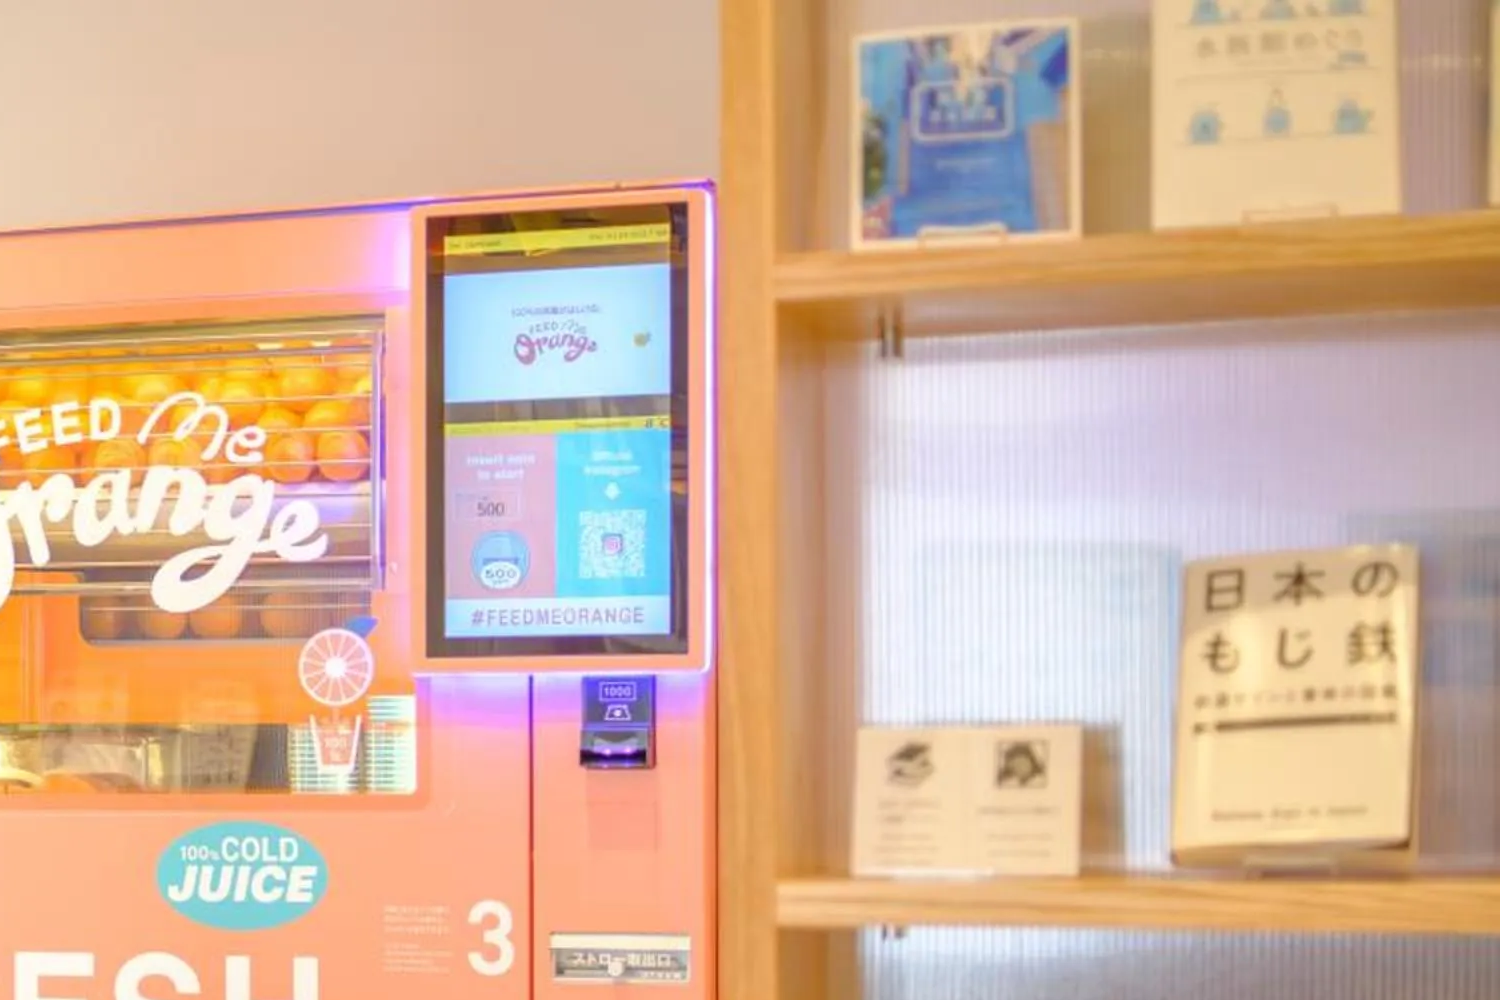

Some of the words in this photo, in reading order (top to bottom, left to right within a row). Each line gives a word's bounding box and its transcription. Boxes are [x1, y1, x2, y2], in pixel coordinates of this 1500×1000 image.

[513, 333, 598, 366] Orange
[477, 502, 506, 517] 500
[485, 566, 518, 579] 500
[1204, 561, 1399, 614] 日本の
[471, 607, 645, 627] #FEEDMEORANGE
[1202, 619, 1398, 676] もじ鉄
[603, 685, 632, 698] 1000
[221, 836, 299, 863] COLD
[167, 864, 318, 904] JUICE
[466, 899, 515, 977] 3
